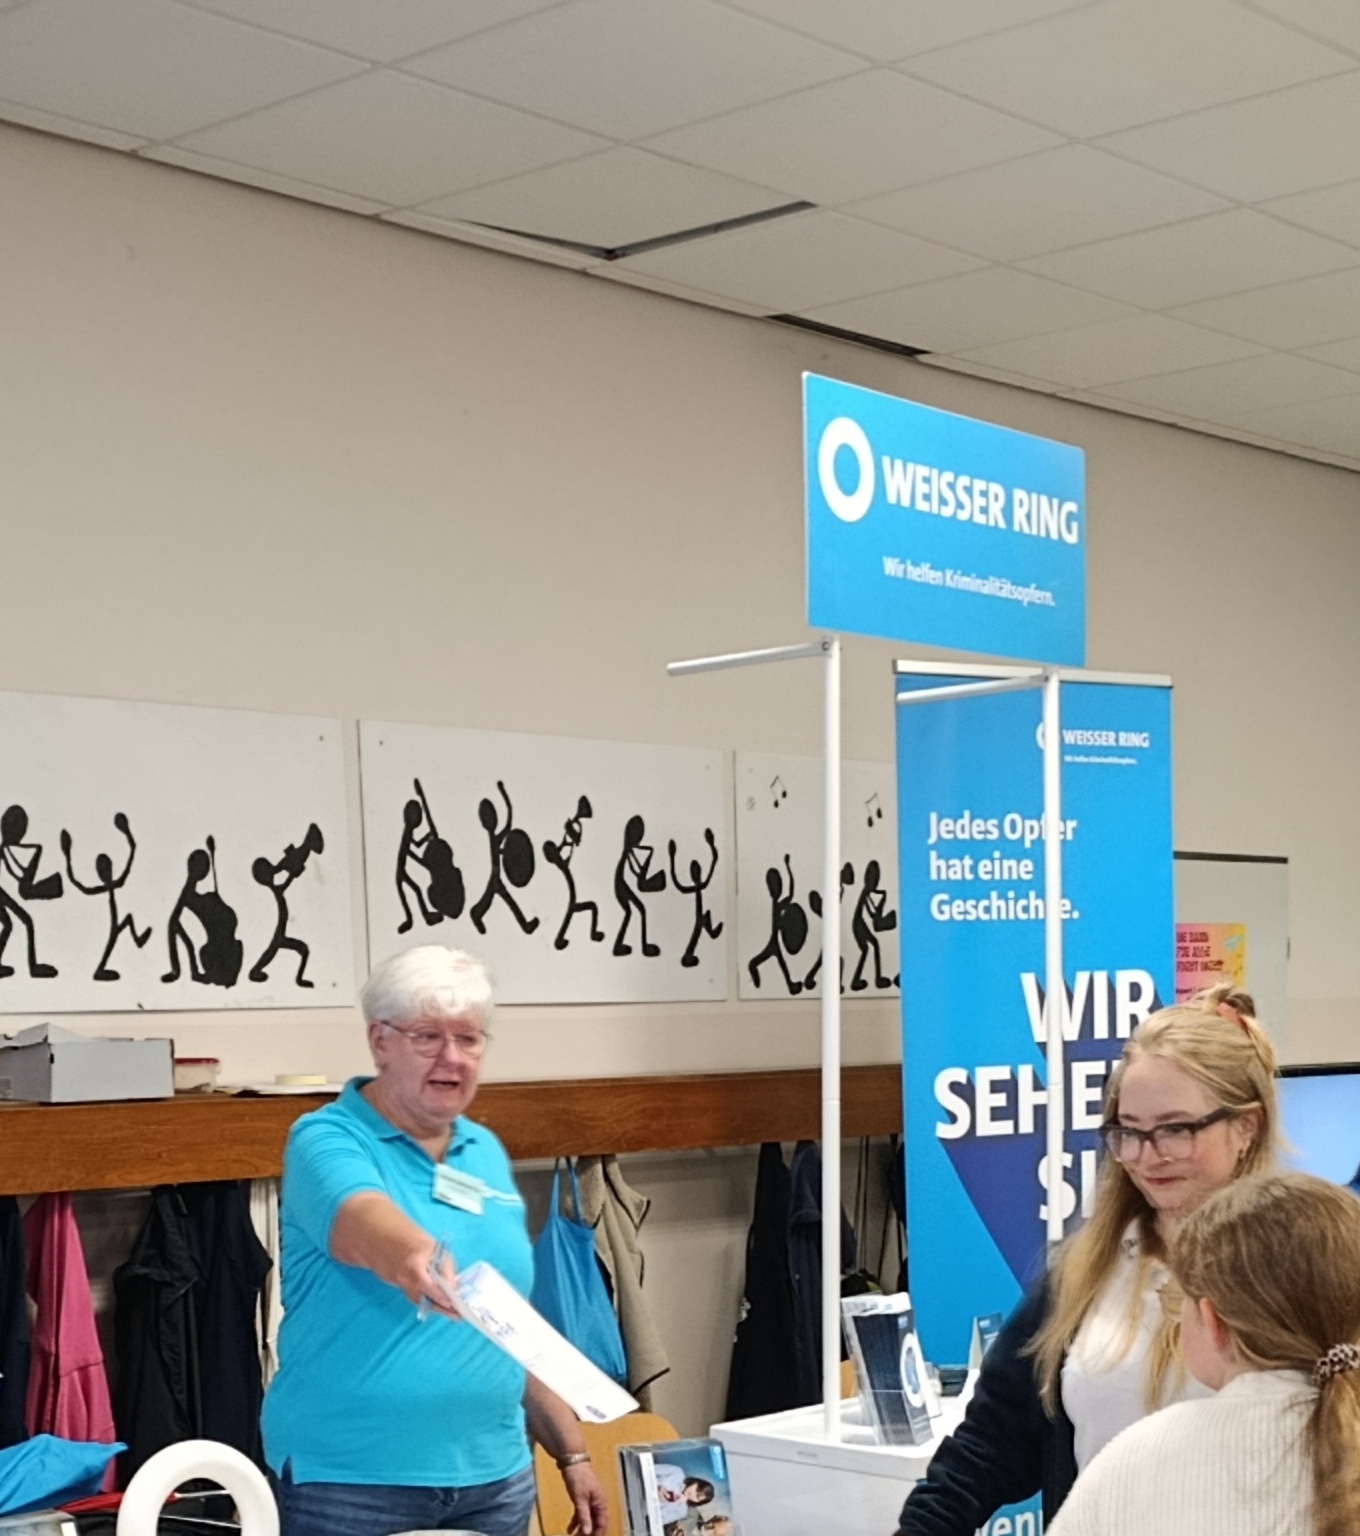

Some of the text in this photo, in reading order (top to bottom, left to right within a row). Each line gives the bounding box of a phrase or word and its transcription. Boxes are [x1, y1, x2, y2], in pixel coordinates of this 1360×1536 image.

[881, 455, 1079, 544] WEISSER RING
[883, 556, 1055, 606] Wir helfen Kriminalitätsopfern.
[1062, 729, 1150, 748] WEISSER RING
[927, 810, 1077, 848] Jedes Oper
[929, 850, 1034, 880] hat eine
[930, 890, 1080, 921] Geschiche.
[1020, 969, 1156, 1042] WIR
[934, 1060, 1124, 1139] SEHE
